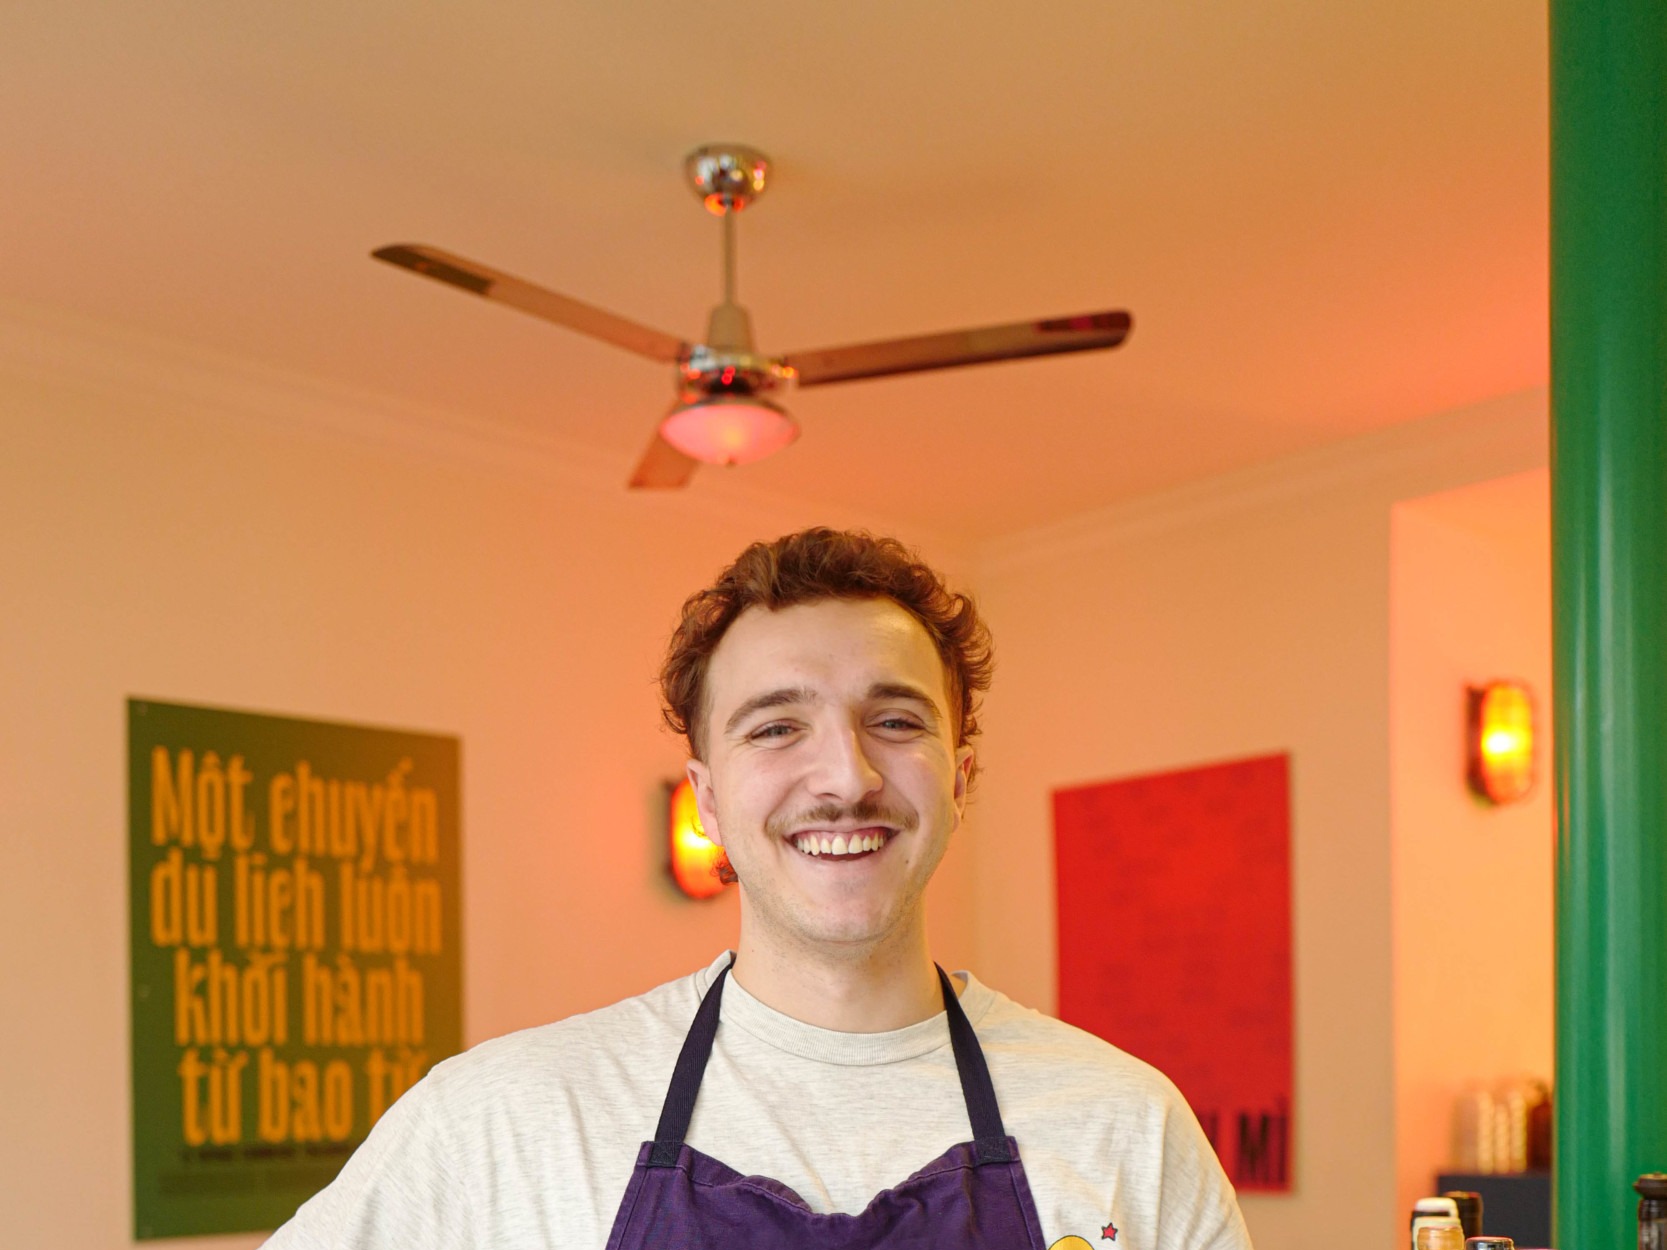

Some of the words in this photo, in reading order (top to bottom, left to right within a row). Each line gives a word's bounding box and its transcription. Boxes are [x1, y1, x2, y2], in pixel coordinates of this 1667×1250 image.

[151, 745, 254, 860] Một
[151, 847, 218, 947] du
[340, 861, 442, 955] luôn
[303, 951, 425, 1047] hành
[258, 1047, 354, 1143] bao
